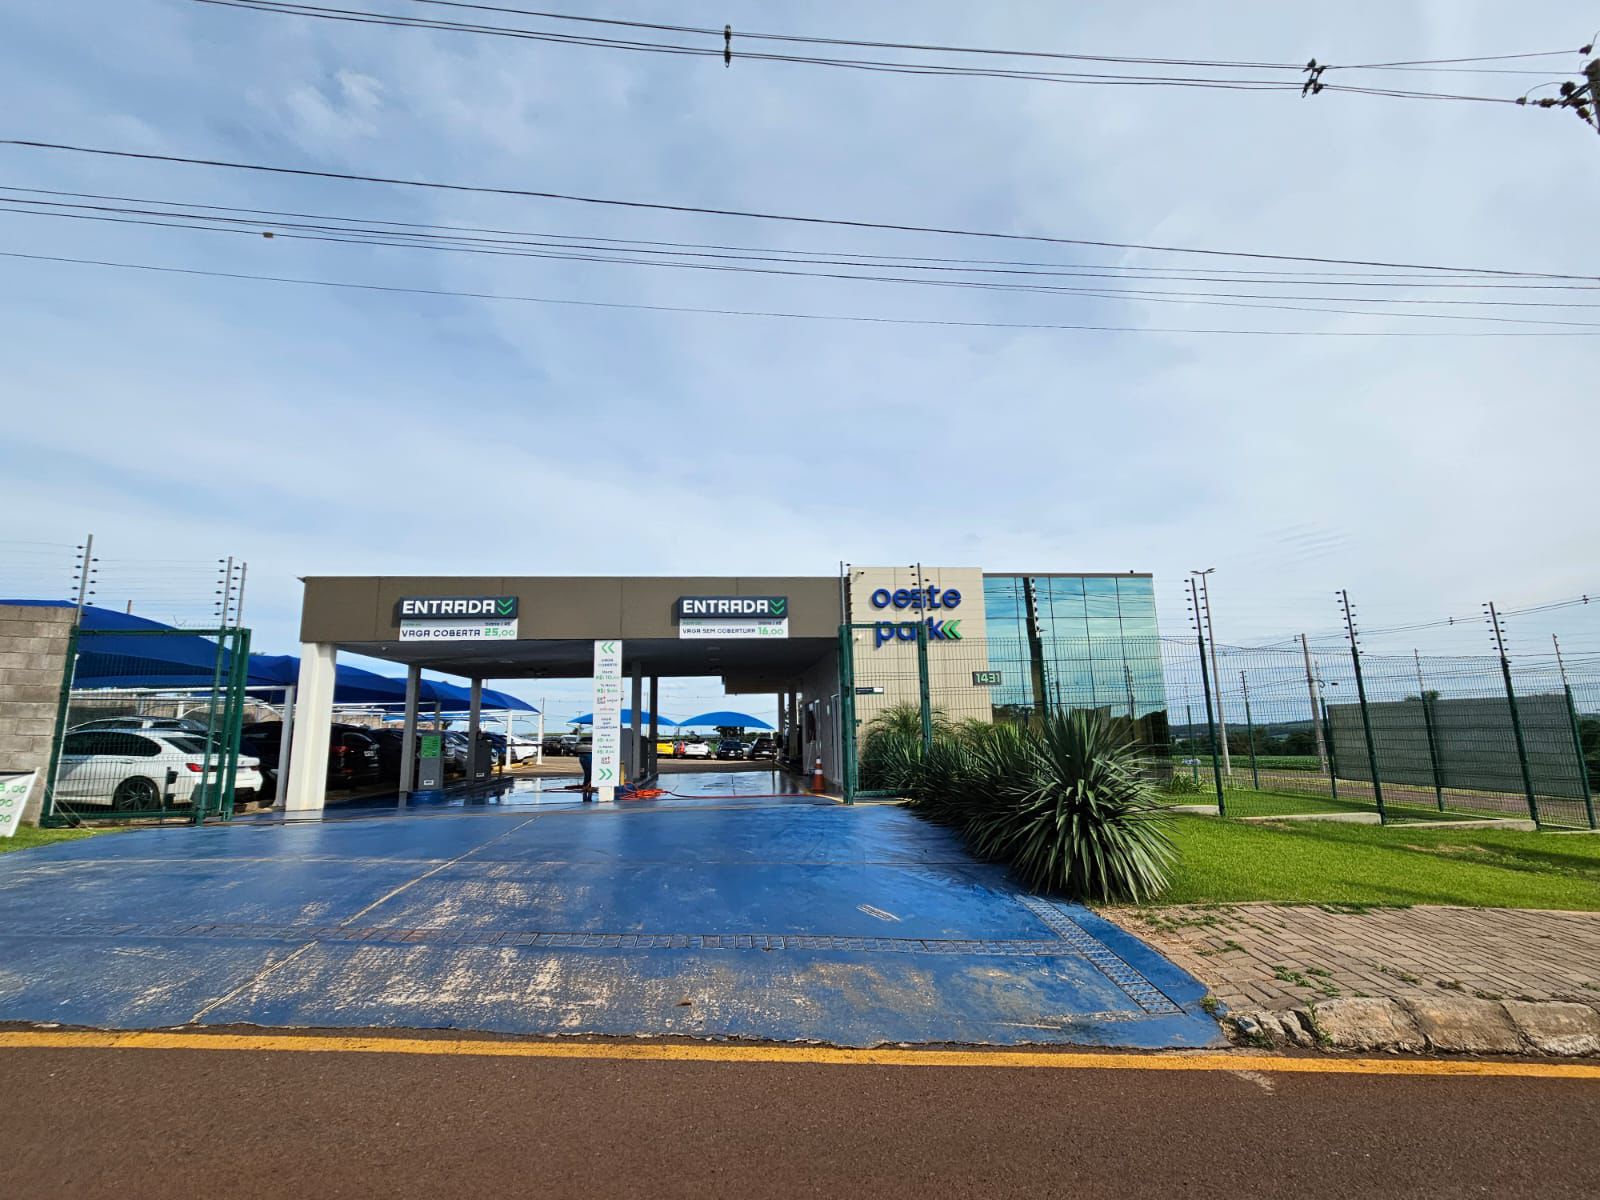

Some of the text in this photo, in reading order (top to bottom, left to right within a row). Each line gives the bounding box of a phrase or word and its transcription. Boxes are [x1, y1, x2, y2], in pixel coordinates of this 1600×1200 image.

[871, 585, 962, 609] oeste
[402, 600, 496, 614] ENTRADA
[683, 599, 769, 614] ENTRADA
[402, 630, 430, 638] VAGA
[484, 628, 515, 638] 25,00
[875, 616, 946, 649] pak
[975, 673, 1001, 683] 1431
